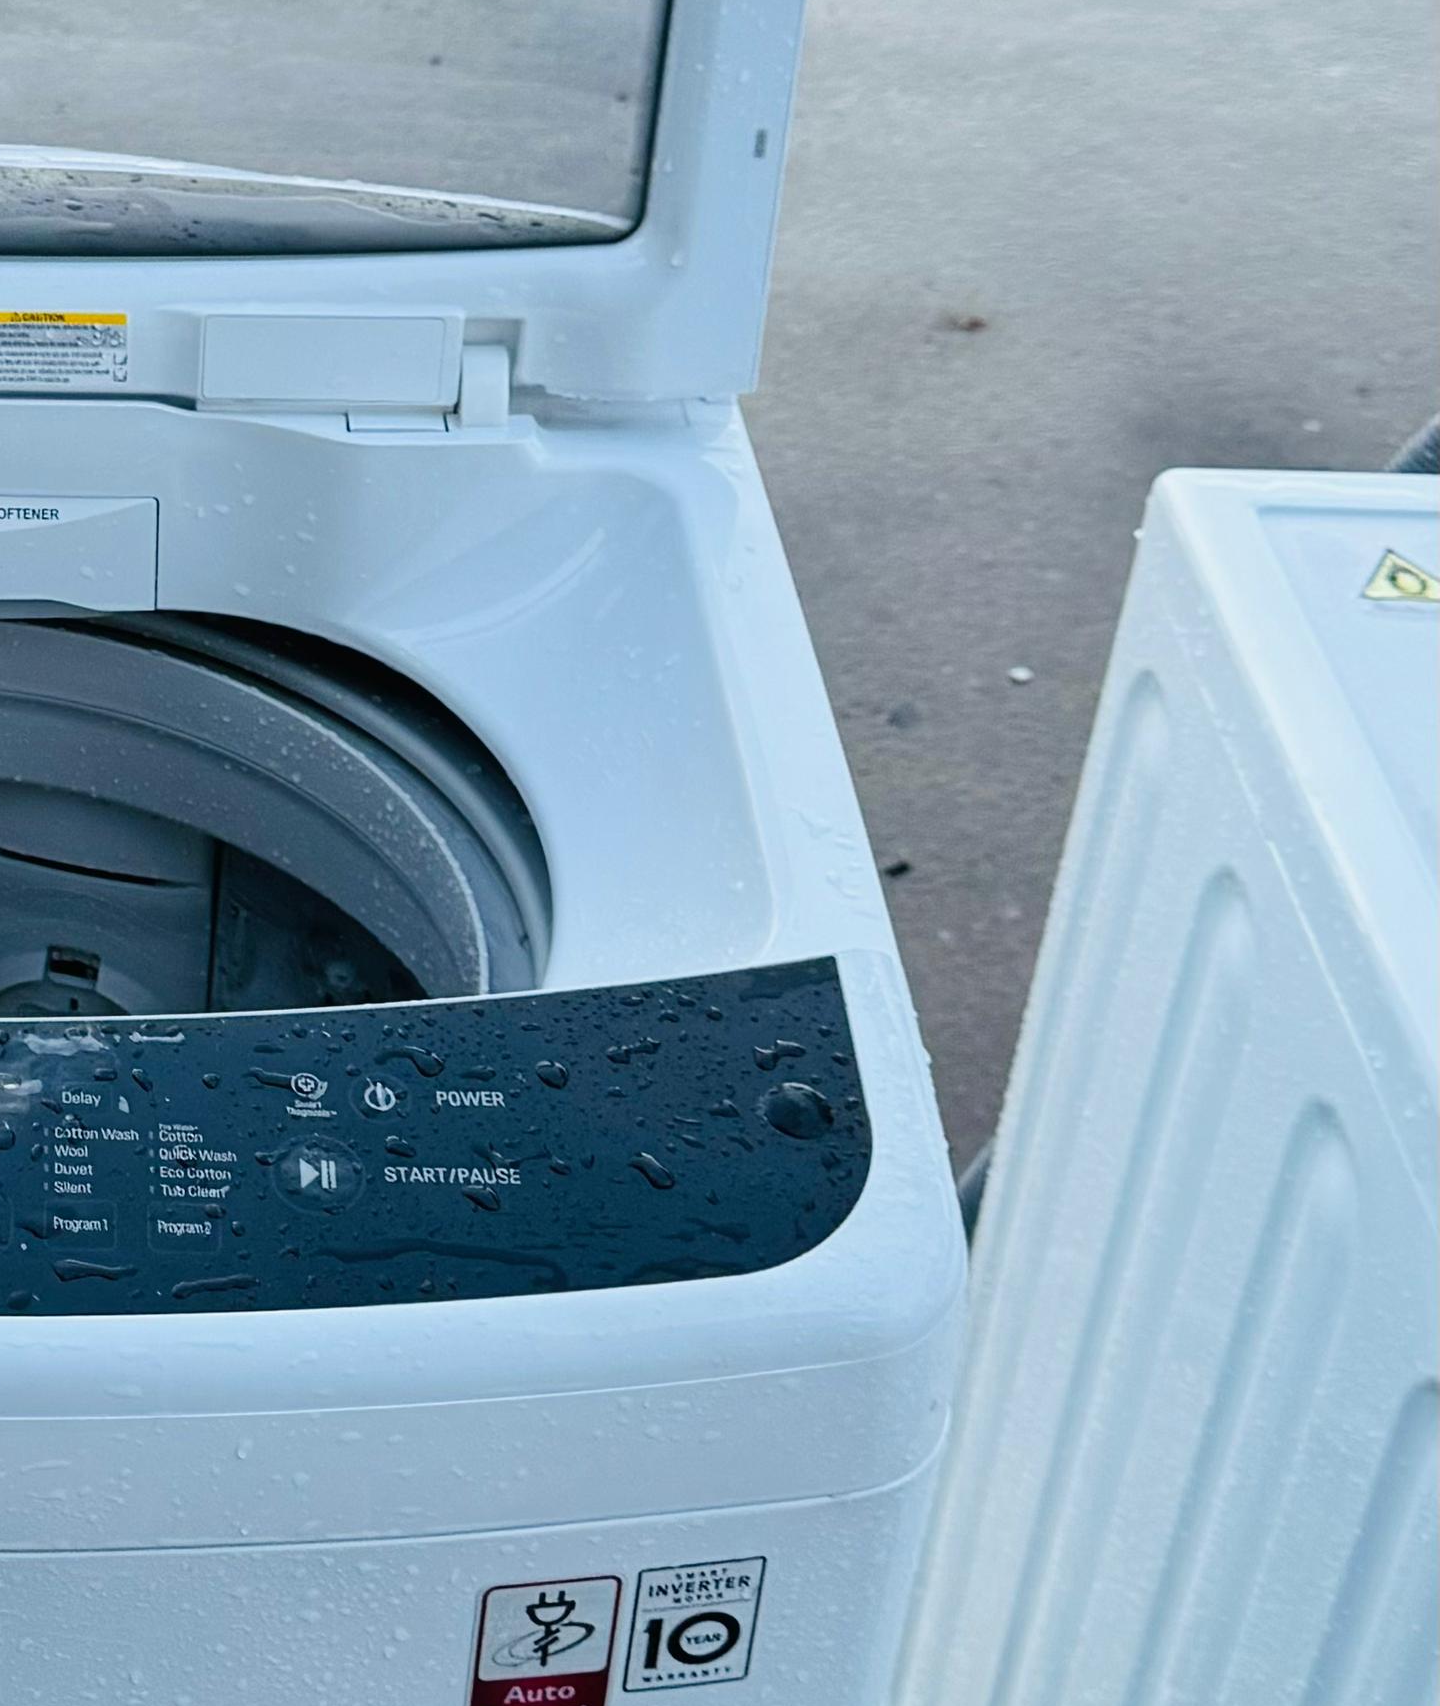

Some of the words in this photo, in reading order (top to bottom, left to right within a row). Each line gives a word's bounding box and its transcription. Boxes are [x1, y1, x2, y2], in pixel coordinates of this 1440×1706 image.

[61, 1090, 101, 1107] Delay
[435, 1090, 506, 1108] POWER
[54, 1126, 99, 1140] Cotton
[100, 1127, 140, 1141] Wash
[158, 1130, 203, 1143] Cotton
[54, 1144, 89, 1158] Wool
[159, 1147, 197, 1161] Quick
[198, 1148, 238, 1162] Wash
[54, 1162, 94, 1176] Duvet
[159, 1165, 185, 1178] Eco
[186, 1167, 232, 1181] Cotton
[383, 1166, 522, 1185] START/PAUSE
[54, 1180, 93, 1194] Silent
[159, 1183, 186, 1197] Tub
[187, 1185, 228, 1199] Clean
[53, 1215, 100, 1233] Program
[157, 1219, 204, 1237] Program
[674, 1567, 728, 1581] SMART
[647, 1575, 752, 1598] INVERTER
[642, 1611, 741, 1670] 10
[684, 1631, 724, 1645] YEAR
[503, 1684, 576, 1705] Auto
